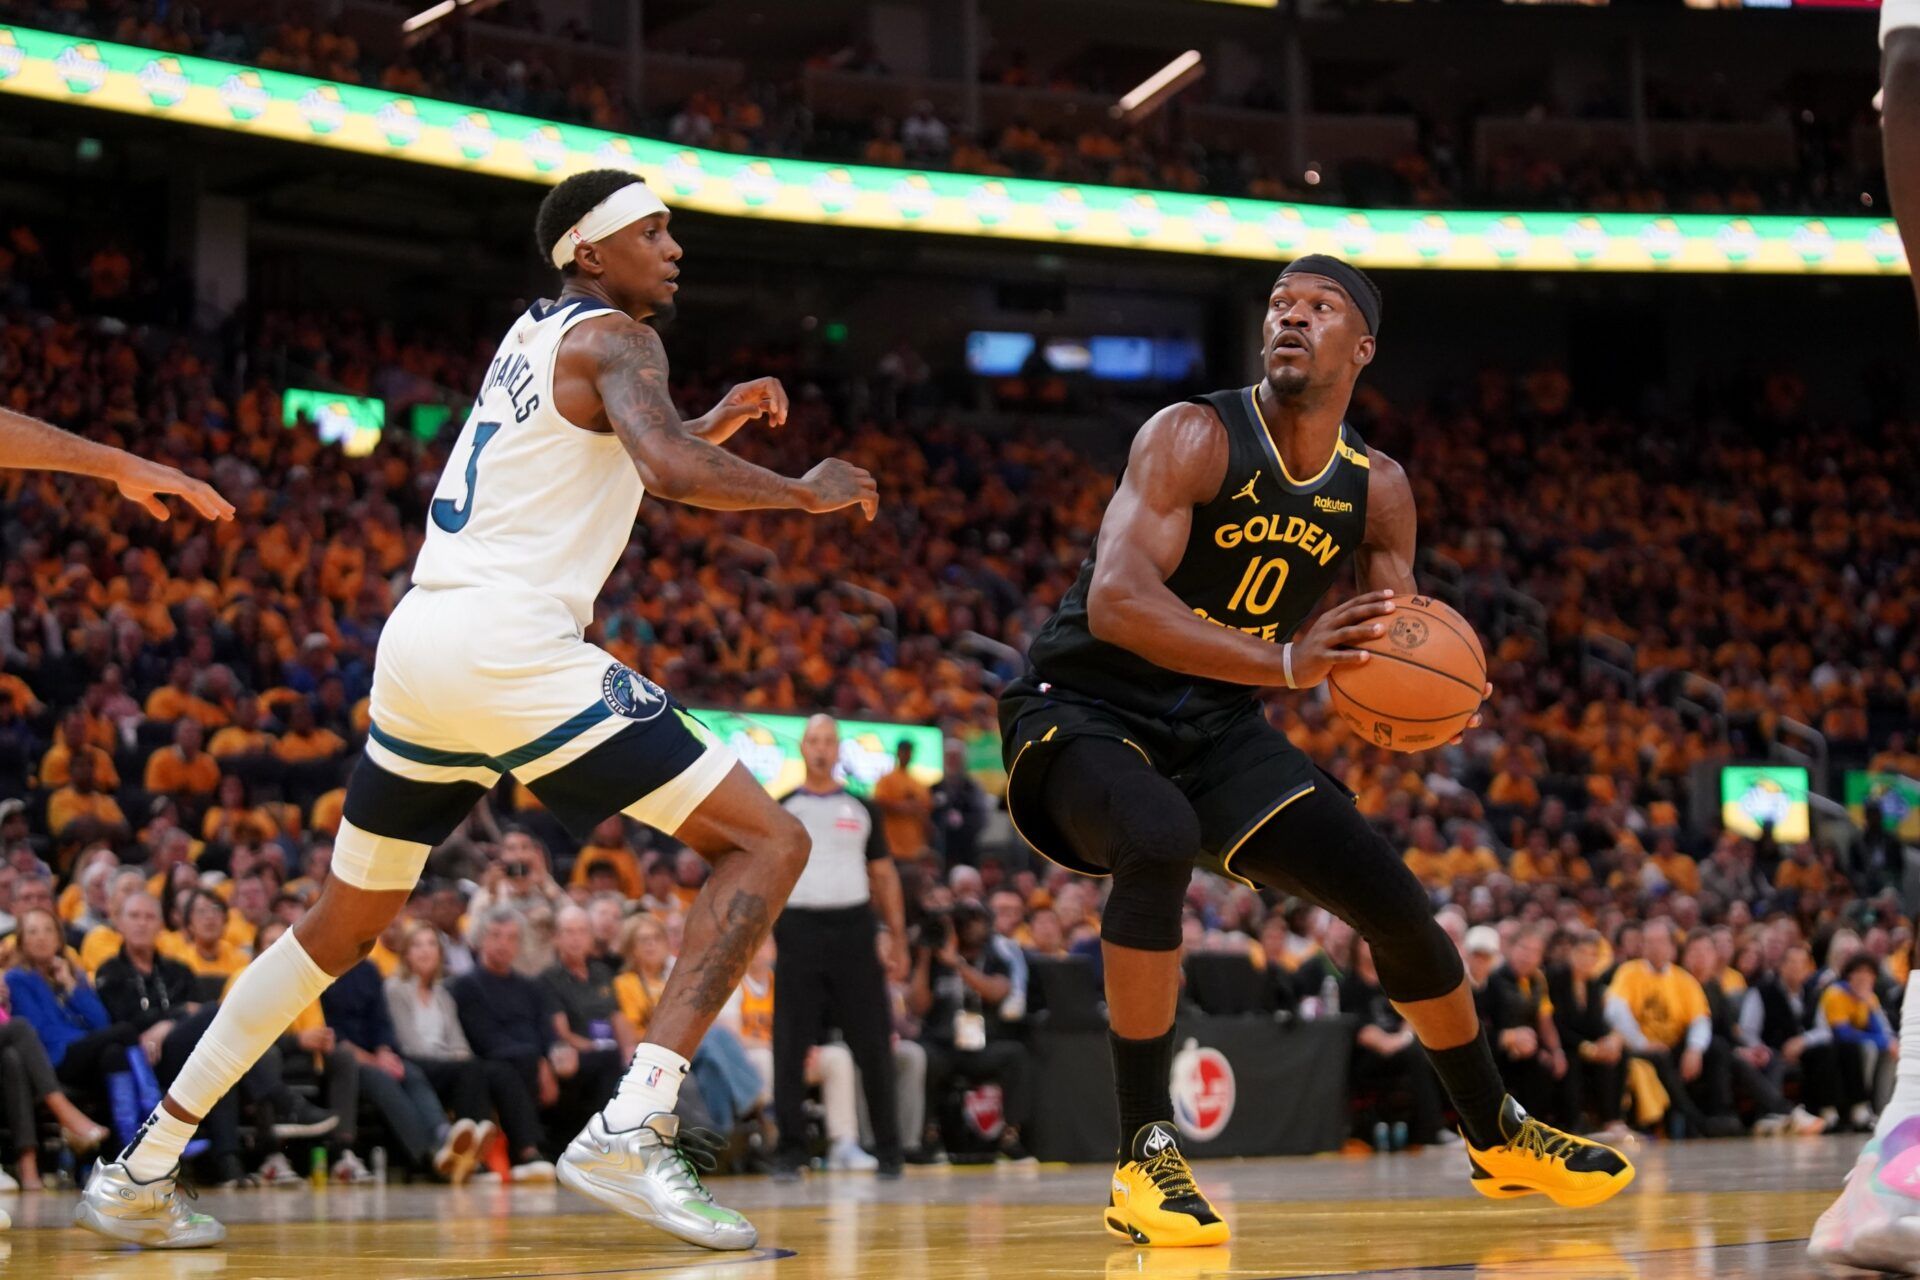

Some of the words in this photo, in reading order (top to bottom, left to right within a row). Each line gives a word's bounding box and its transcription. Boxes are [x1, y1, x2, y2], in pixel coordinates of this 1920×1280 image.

[1313, 495, 1352, 512] Rakuten
[1214, 514, 1340, 567] GOLDEN
[1226, 555, 1290, 616] 10
[603, 669, 626, 715] MINNESOTA
